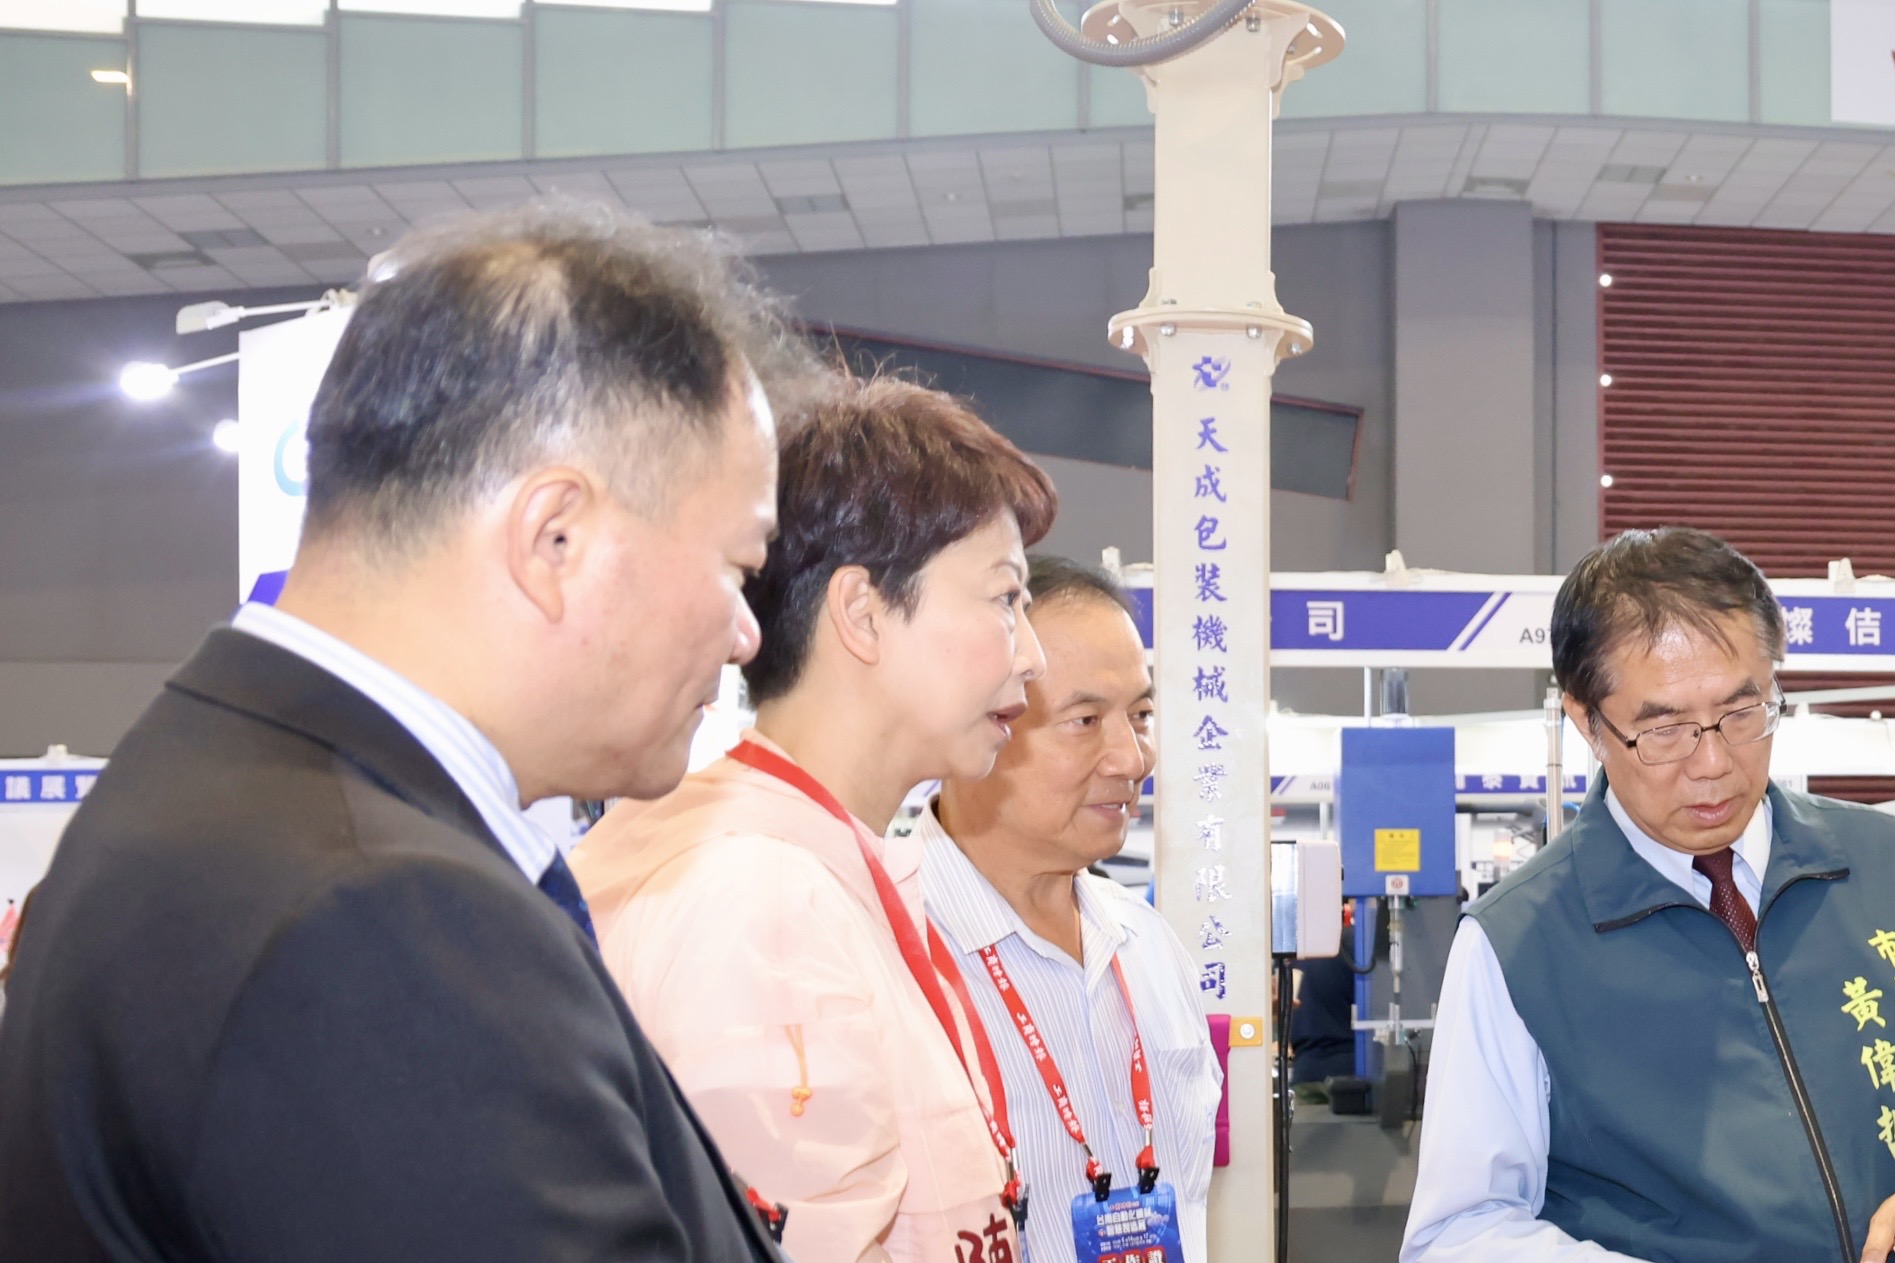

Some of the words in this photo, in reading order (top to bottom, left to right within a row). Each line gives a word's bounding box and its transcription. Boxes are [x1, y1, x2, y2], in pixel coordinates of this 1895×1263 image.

[1306, 600, 1344, 641] 司
[1519, 628, 1552, 645] A9
[1192, 416, 1232, 1000] 天成包裝機械企業有限公司
